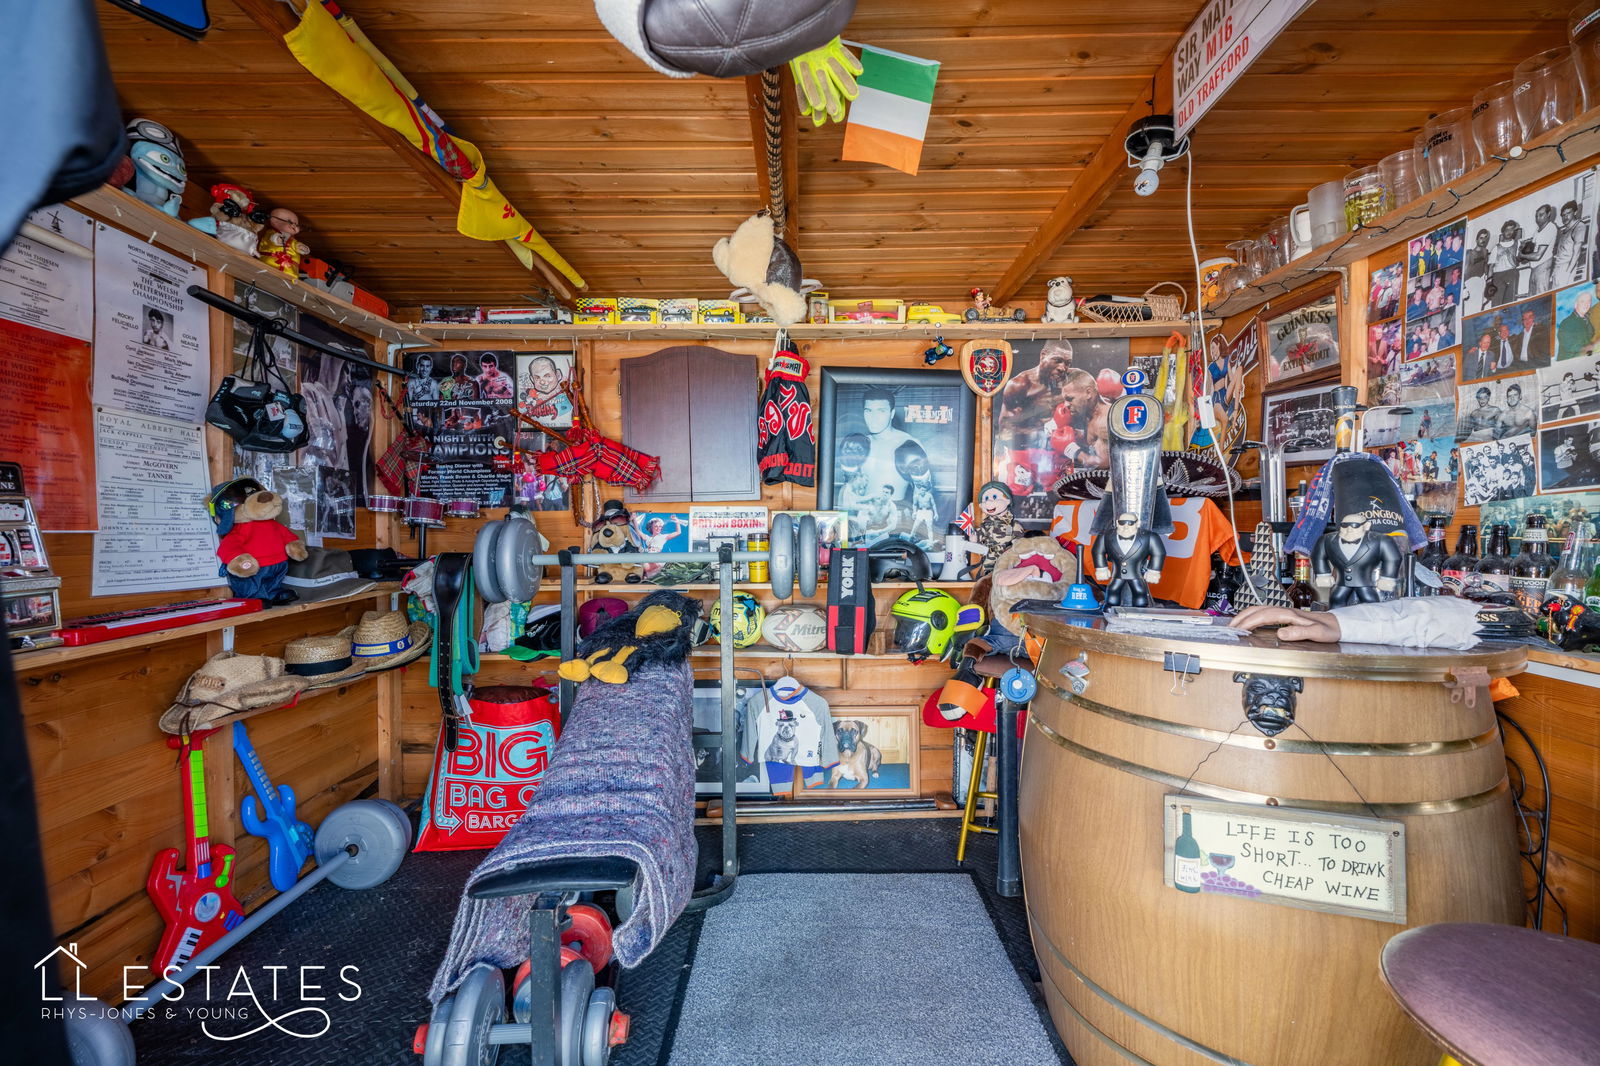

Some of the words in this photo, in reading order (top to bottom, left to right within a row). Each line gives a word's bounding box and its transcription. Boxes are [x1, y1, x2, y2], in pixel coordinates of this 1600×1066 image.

[1177, 31, 1198, 73] SIR
[1177, 52, 1201, 97] WAY
[1206, 15, 1233, 65] M16
[1178, 98, 1194, 128] OLD
[1197, 36, 1249, 106] TRAFFORD
[127, 244, 146, 255] NORTH
[146, 252, 160, 262] WEST
[160, 258, 189, 275] PROMOTIONS
[132, 280, 184, 305] WELTERWEIGHT
[141, 276, 153, 286] THE
[157, 282, 179, 296] WELSH
[132, 288, 185, 313] CHAMPIONSHIP
[117, 311, 134, 321] ROCKY
[1277, 310, 1332, 341] GUINNESS
[1283, 358, 1305, 371] EXTRA
[1306, 347, 1330, 364] STOUT
[1126, 405, 1144, 425] F
[99, 415, 131, 426] ROYAL
[141, 423, 174, 433] ALBERT
[180, 430, 200, 438] HALL
[99, 439, 129, 447] TUESDAY
[137, 443, 168, 452] DECEMBER
[433, 435, 464, 443] NIGHT
[468, 433, 495, 442] WITH
[429, 443, 511, 456] AMPIONS
[143, 460, 179, 470] McGOVERN
[147, 472, 173, 480] TANNER
[692, 518, 729, 528] BRITISH
[1359, 509, 1404, 523] RONGBOW
[841, 555, 855, 599] YORK
[1071, 592, 1088, 600] BEER
[791, 624, 827, 635] Mitre
[447, 727, 549, 779] BIG
[449, 783, 507, 809] BAG
[468, 814, 526, 829] BARG
[1226, 821, 1276, 841] LIFE
[1288, 831, 1314, 846] IS
[1329, 834, 1366, 852] TOO
[1318, 856, 1336, 871] TO
[1342, 859, 1386, 878] DRINK
[1262, 870, 1314, 891] CHEAP
[1325, 880, 1380, 901] WINE
